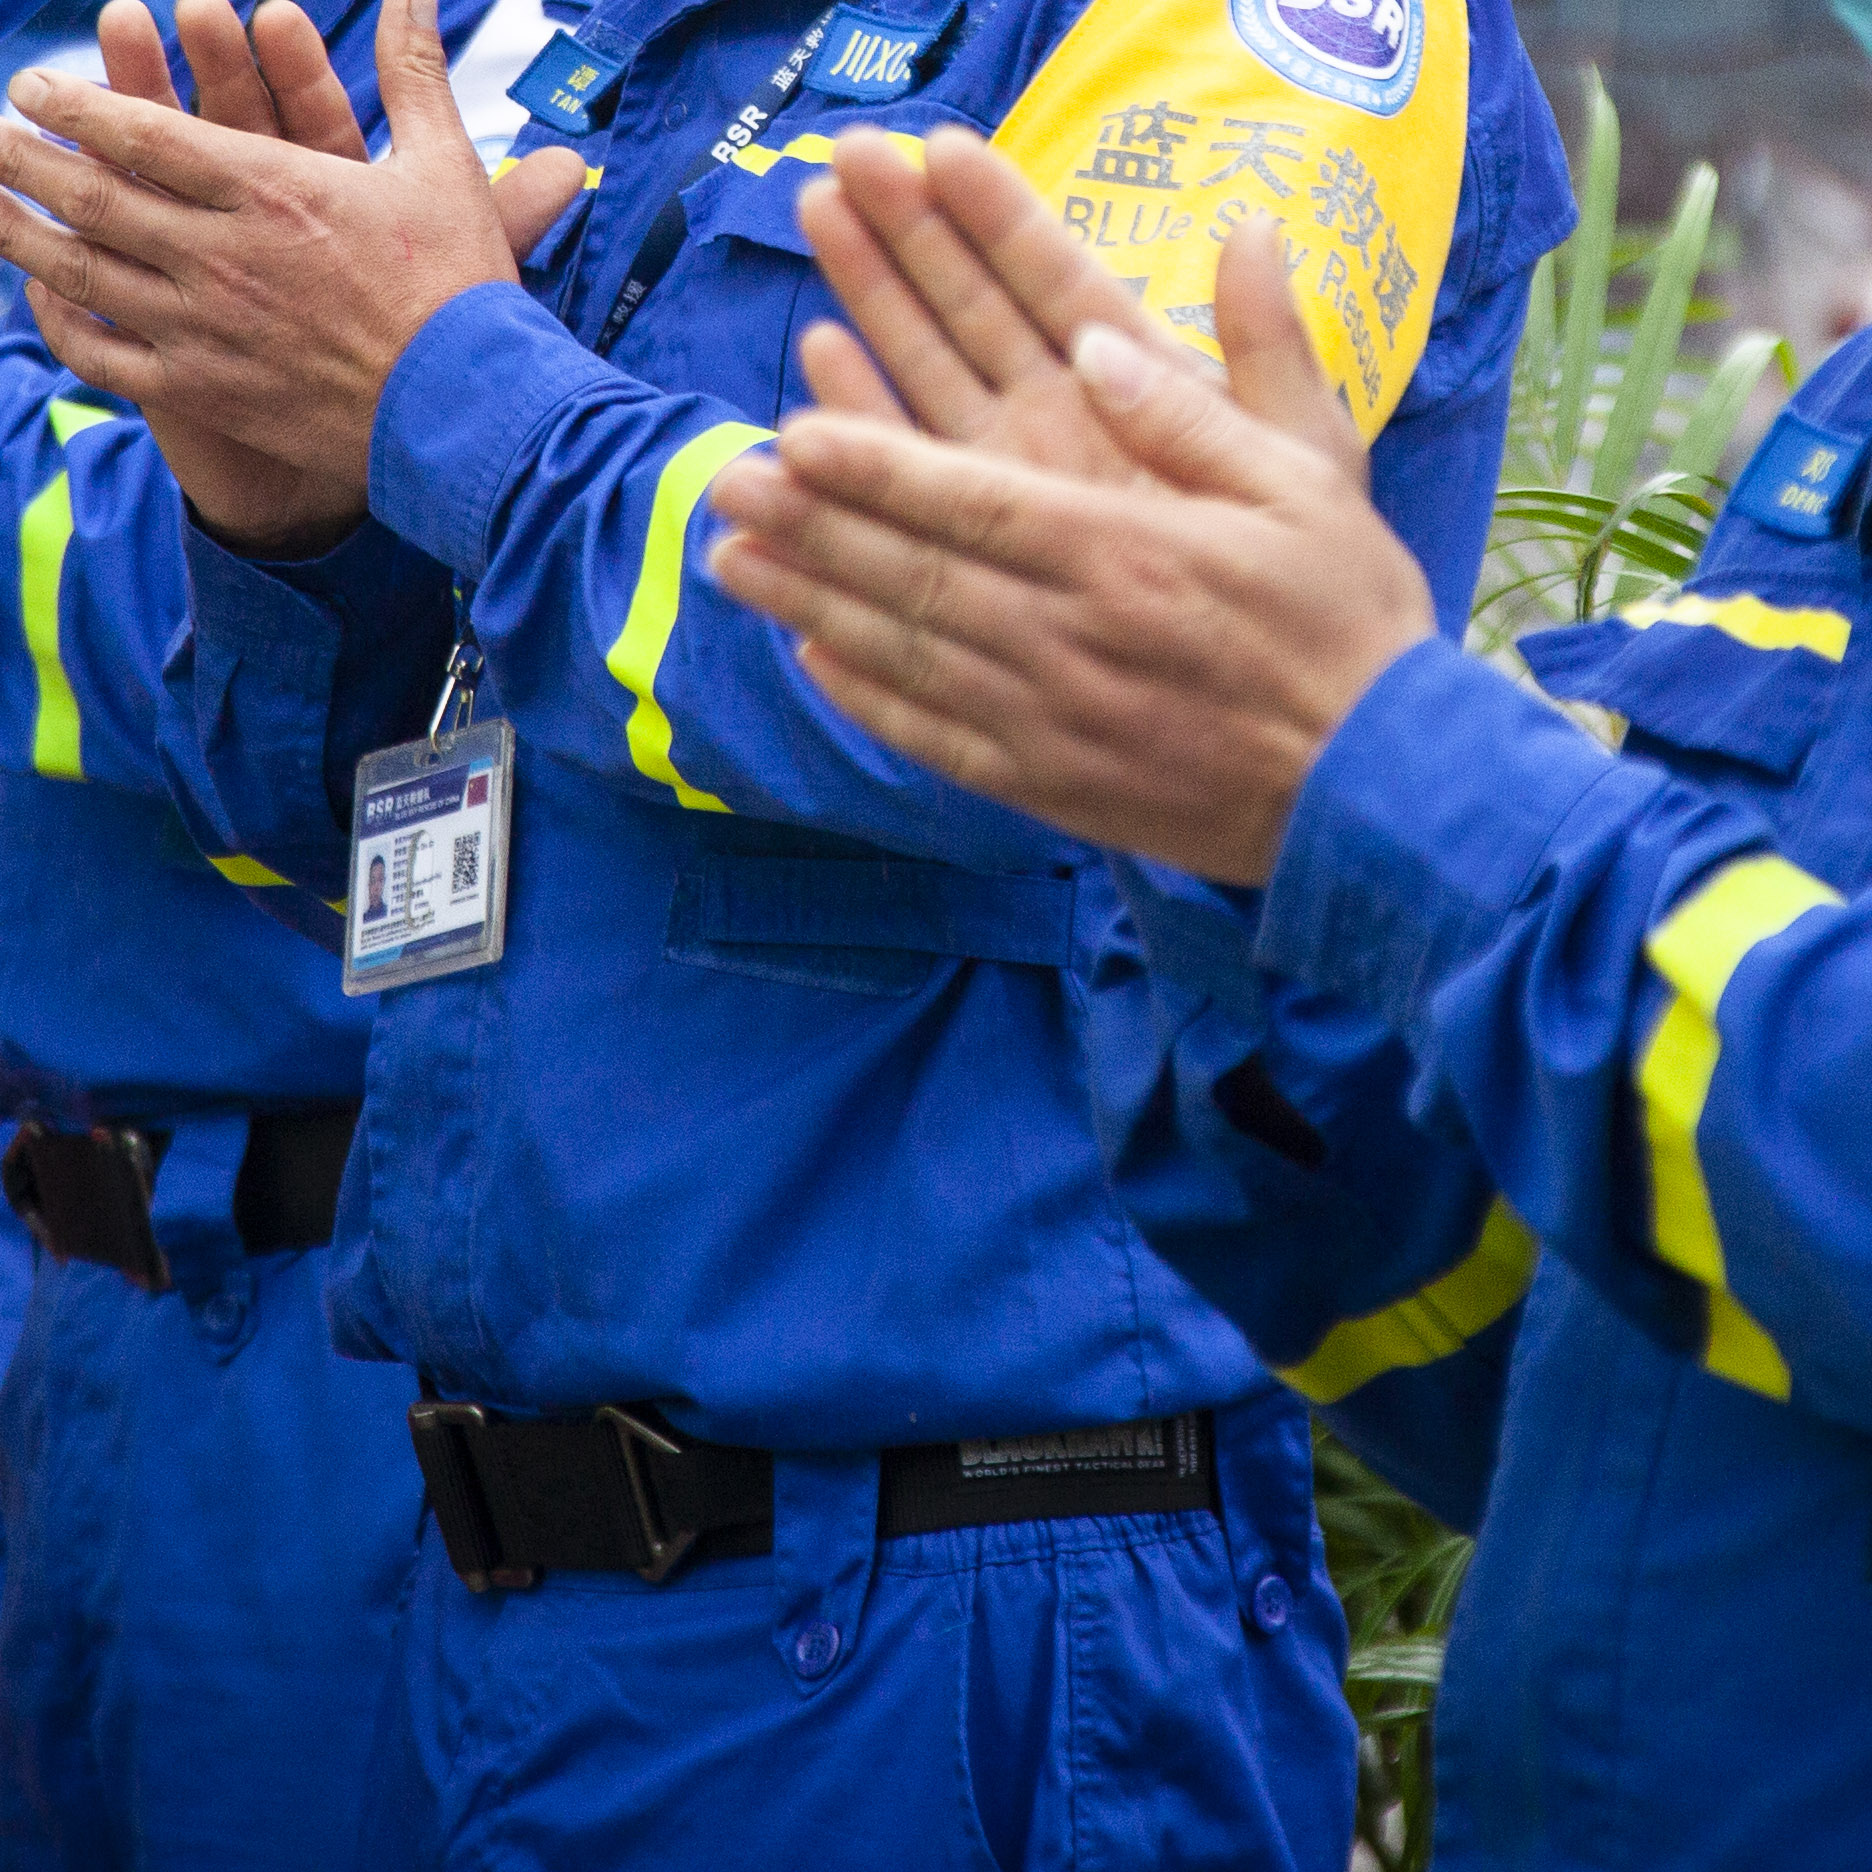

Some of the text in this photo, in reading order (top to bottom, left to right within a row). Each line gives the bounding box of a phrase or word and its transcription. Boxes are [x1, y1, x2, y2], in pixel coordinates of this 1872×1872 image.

[711, 104, 769, 164] BSR
[1074, 100, 1419, 352] 蓝天救援
